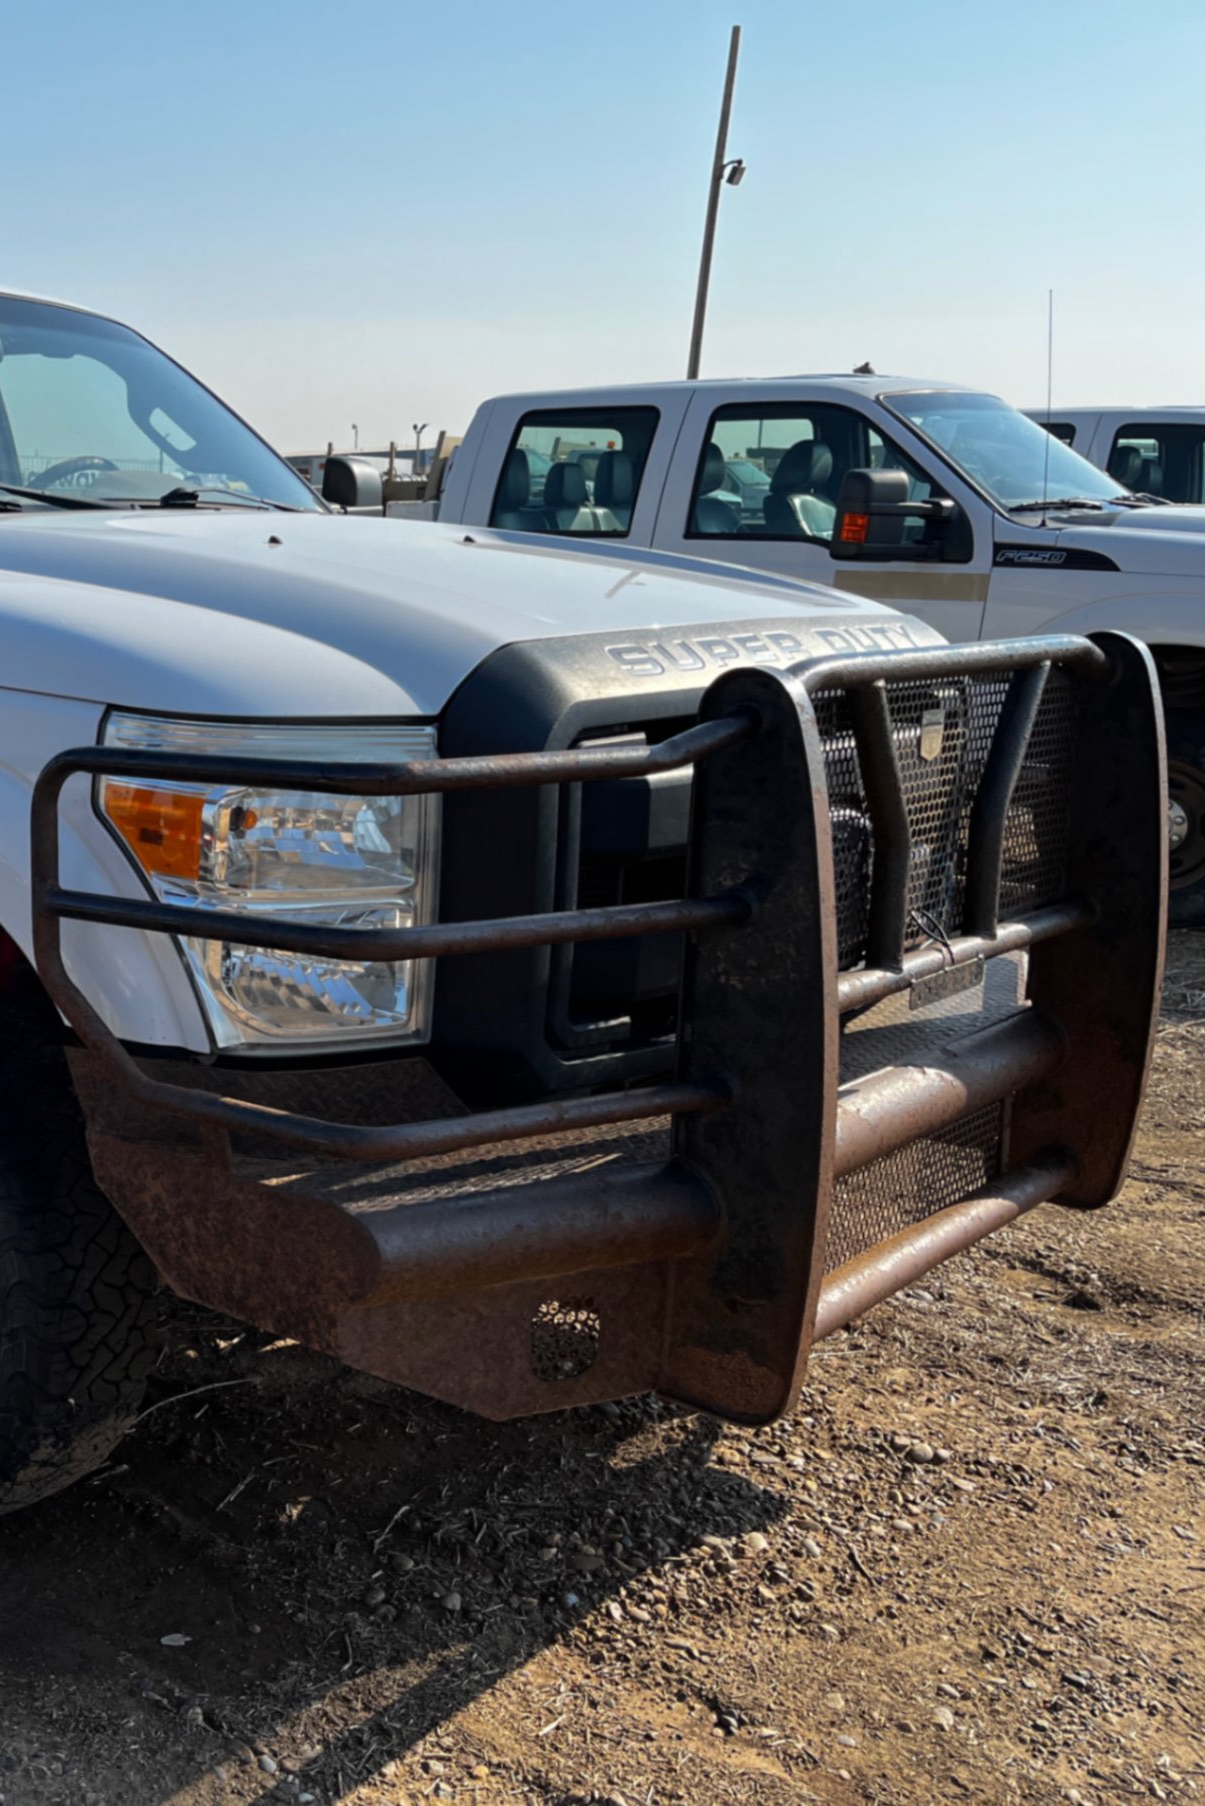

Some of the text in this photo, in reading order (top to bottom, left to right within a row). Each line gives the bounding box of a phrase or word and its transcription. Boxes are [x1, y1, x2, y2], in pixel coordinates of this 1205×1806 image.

[995, 549, 1067, 564] F250
[604, 623, 919, 677] SUPER DUTY
